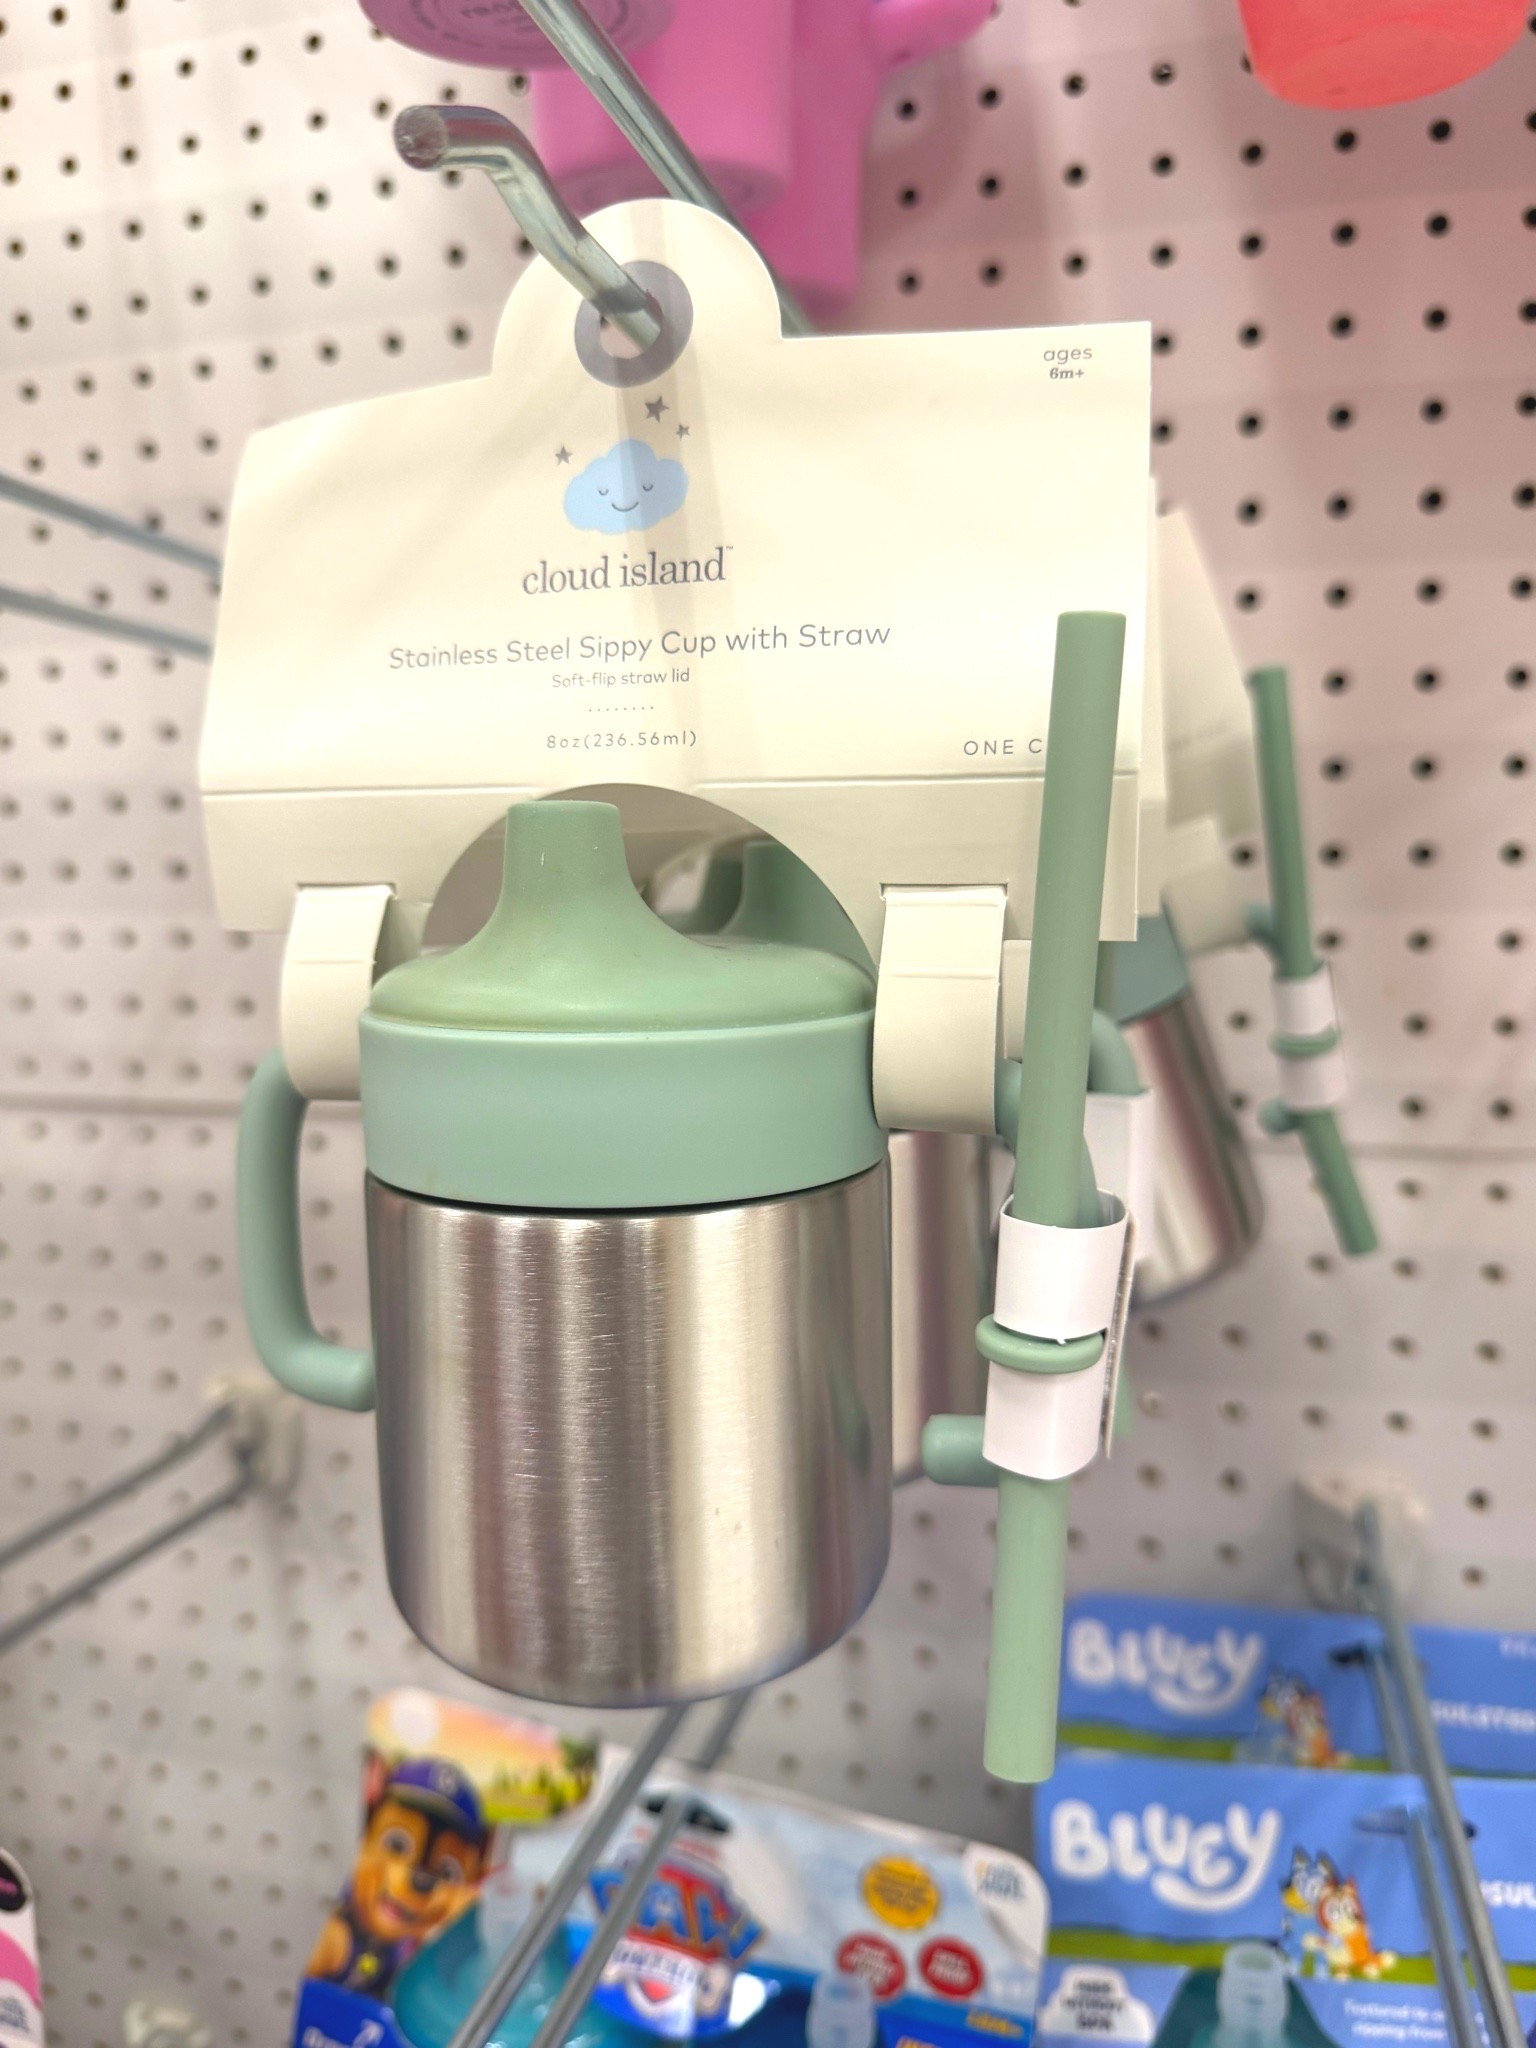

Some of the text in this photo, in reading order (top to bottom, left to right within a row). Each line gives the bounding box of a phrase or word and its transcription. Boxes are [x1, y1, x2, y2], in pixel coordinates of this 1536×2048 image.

[1044, 348, 1092, 364] ages
[1050, 367, 1084, 379] 6m+
[522, 555, 611, 595] cloud
[619, 546, 726, 588] island
[389, 624, 890, 669] Stainless Steel Sippy Cup with Straw
[552, 667, 690, 688] Soft-flip straw lid
[546, 730, 697, 749] 8oz(236.56ml)
[963, 739, 1014, 756] ONE
